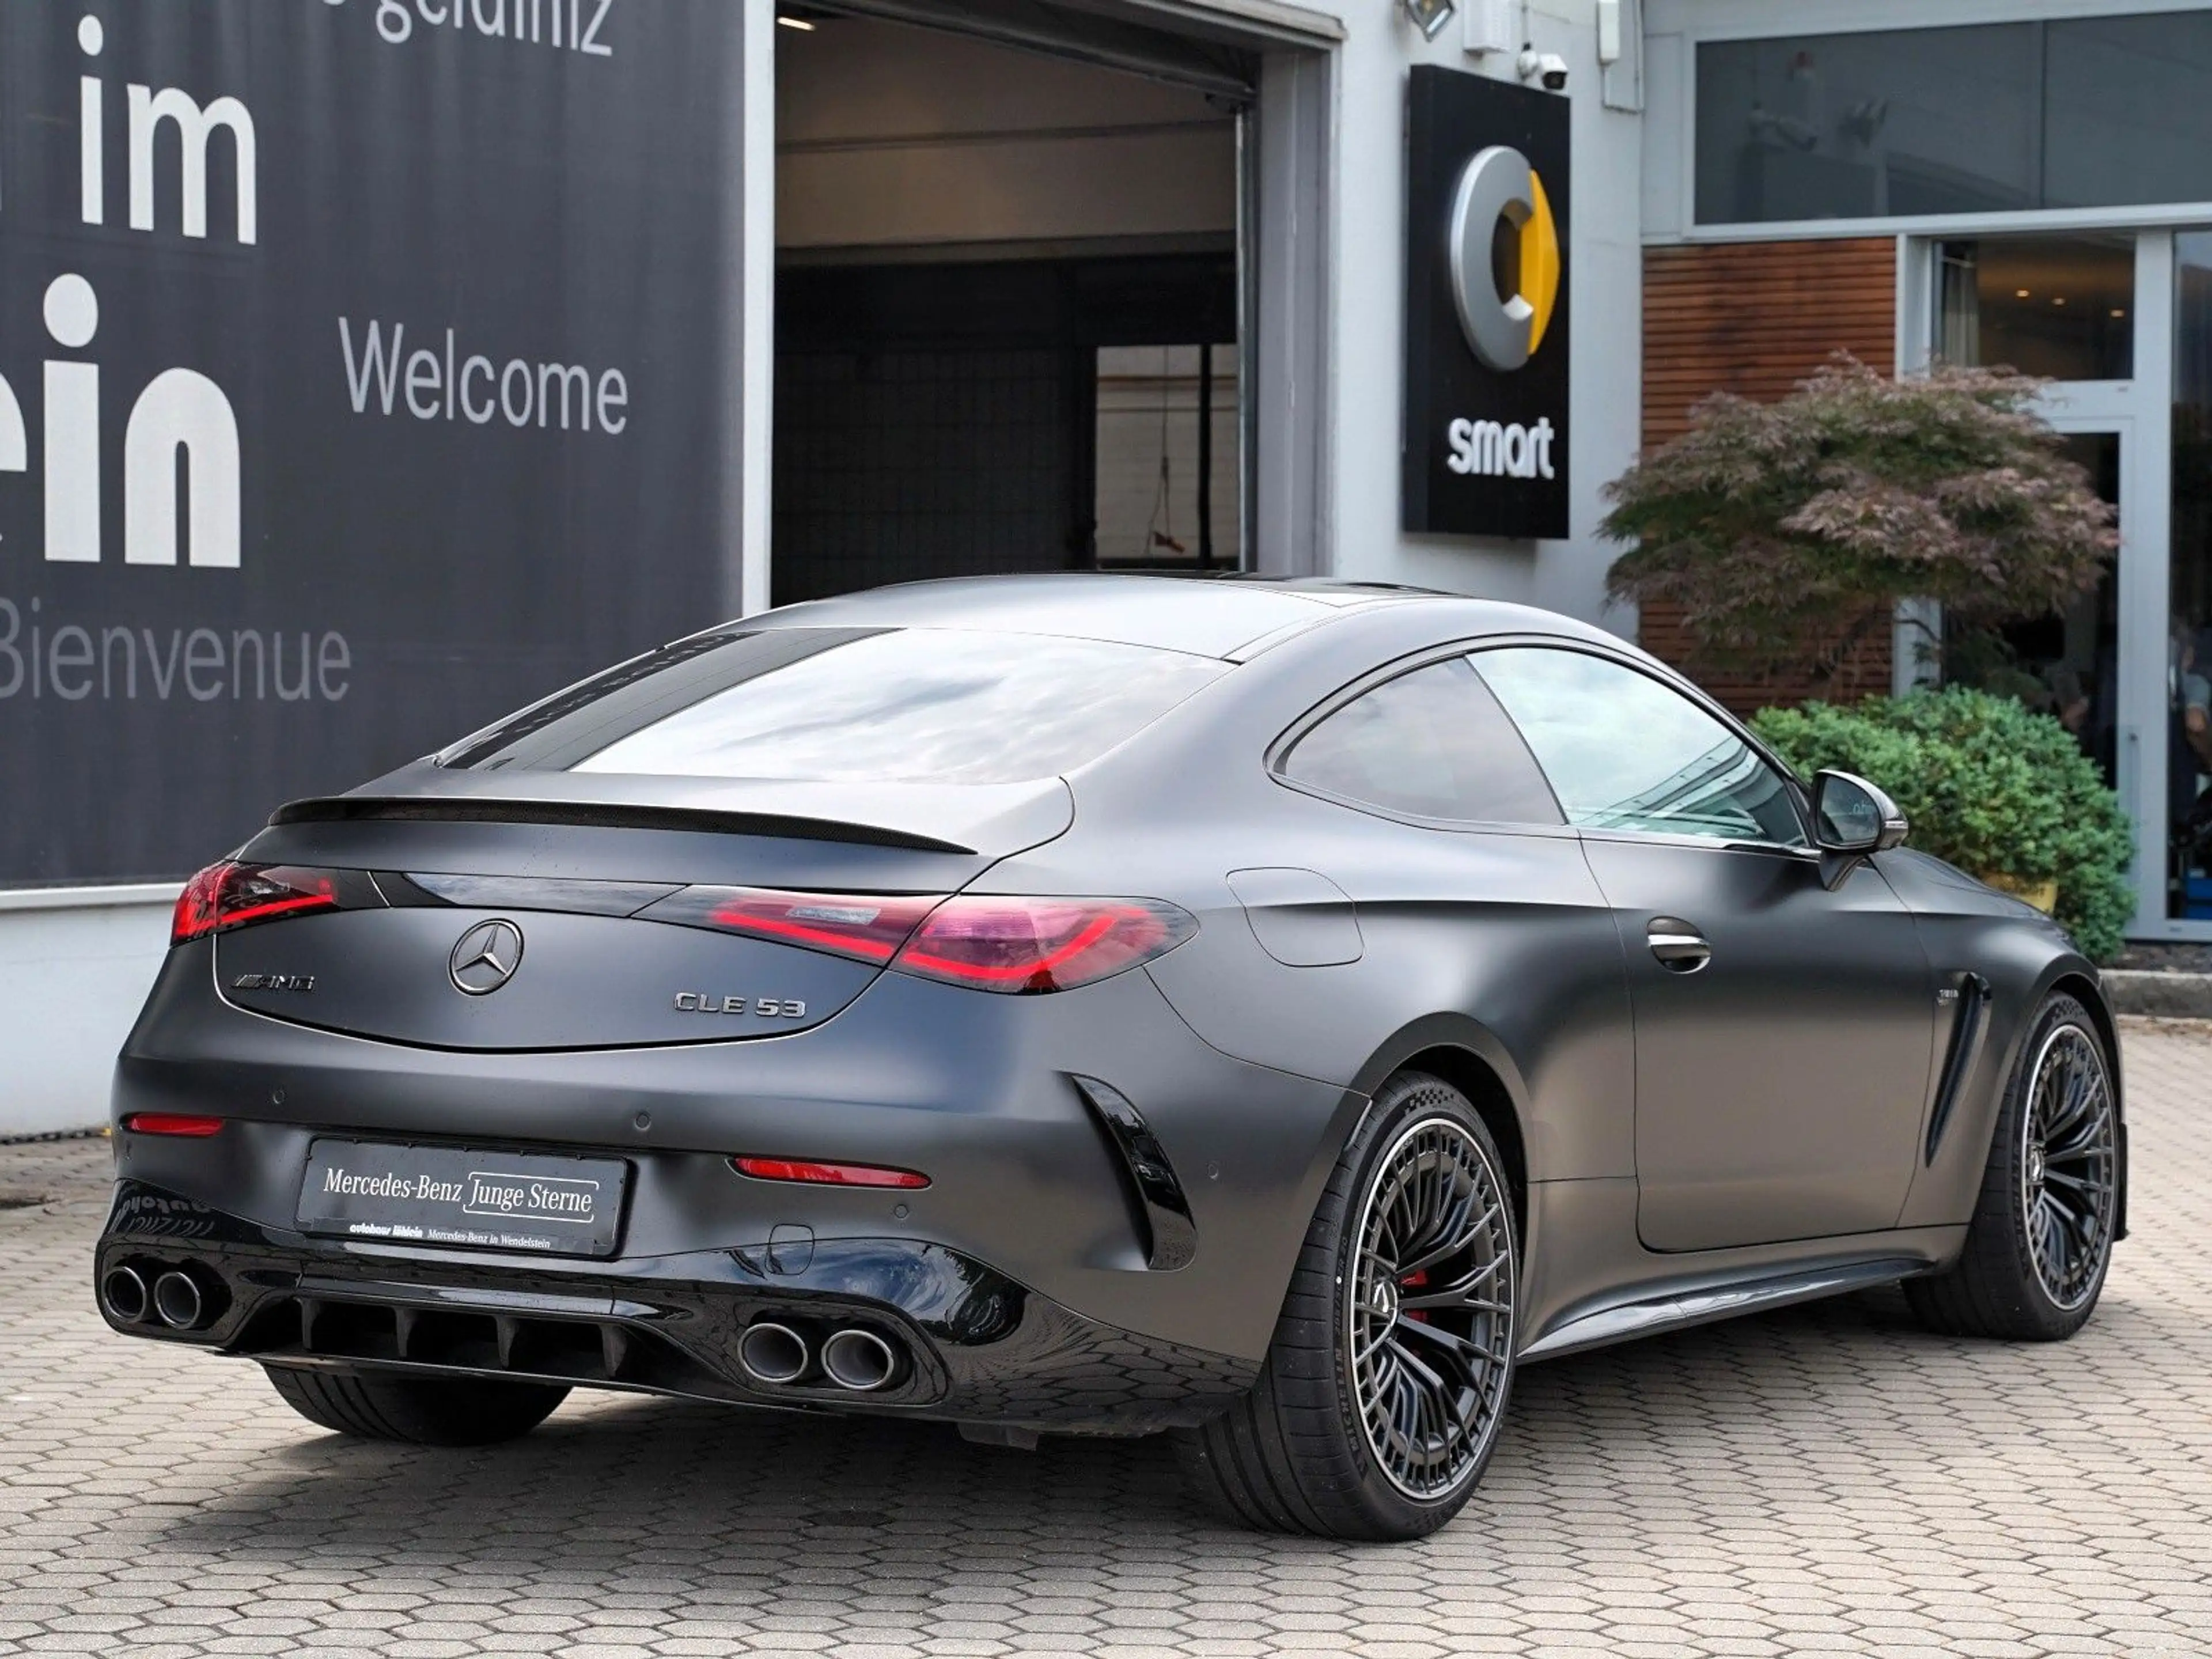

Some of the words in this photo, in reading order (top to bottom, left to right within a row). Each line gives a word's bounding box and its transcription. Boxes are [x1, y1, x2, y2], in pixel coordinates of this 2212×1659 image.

[77, 14, 256, 245] im
[338, 316, 628, 435] Welcome
[0, 272, 241, 568] in
[1446, 416, 1555, 480] smart
[673, 992, 747, 1014] CLE
[755, 998, 807, 1018] 53
[323, 1168, 464, 1202] Mercedes-Benz
[468, 1179, 524, 1211] Junge
[527, 1183, 592, 1213] Sterne
[501, 1234, 551, 1249] Wendelstein
